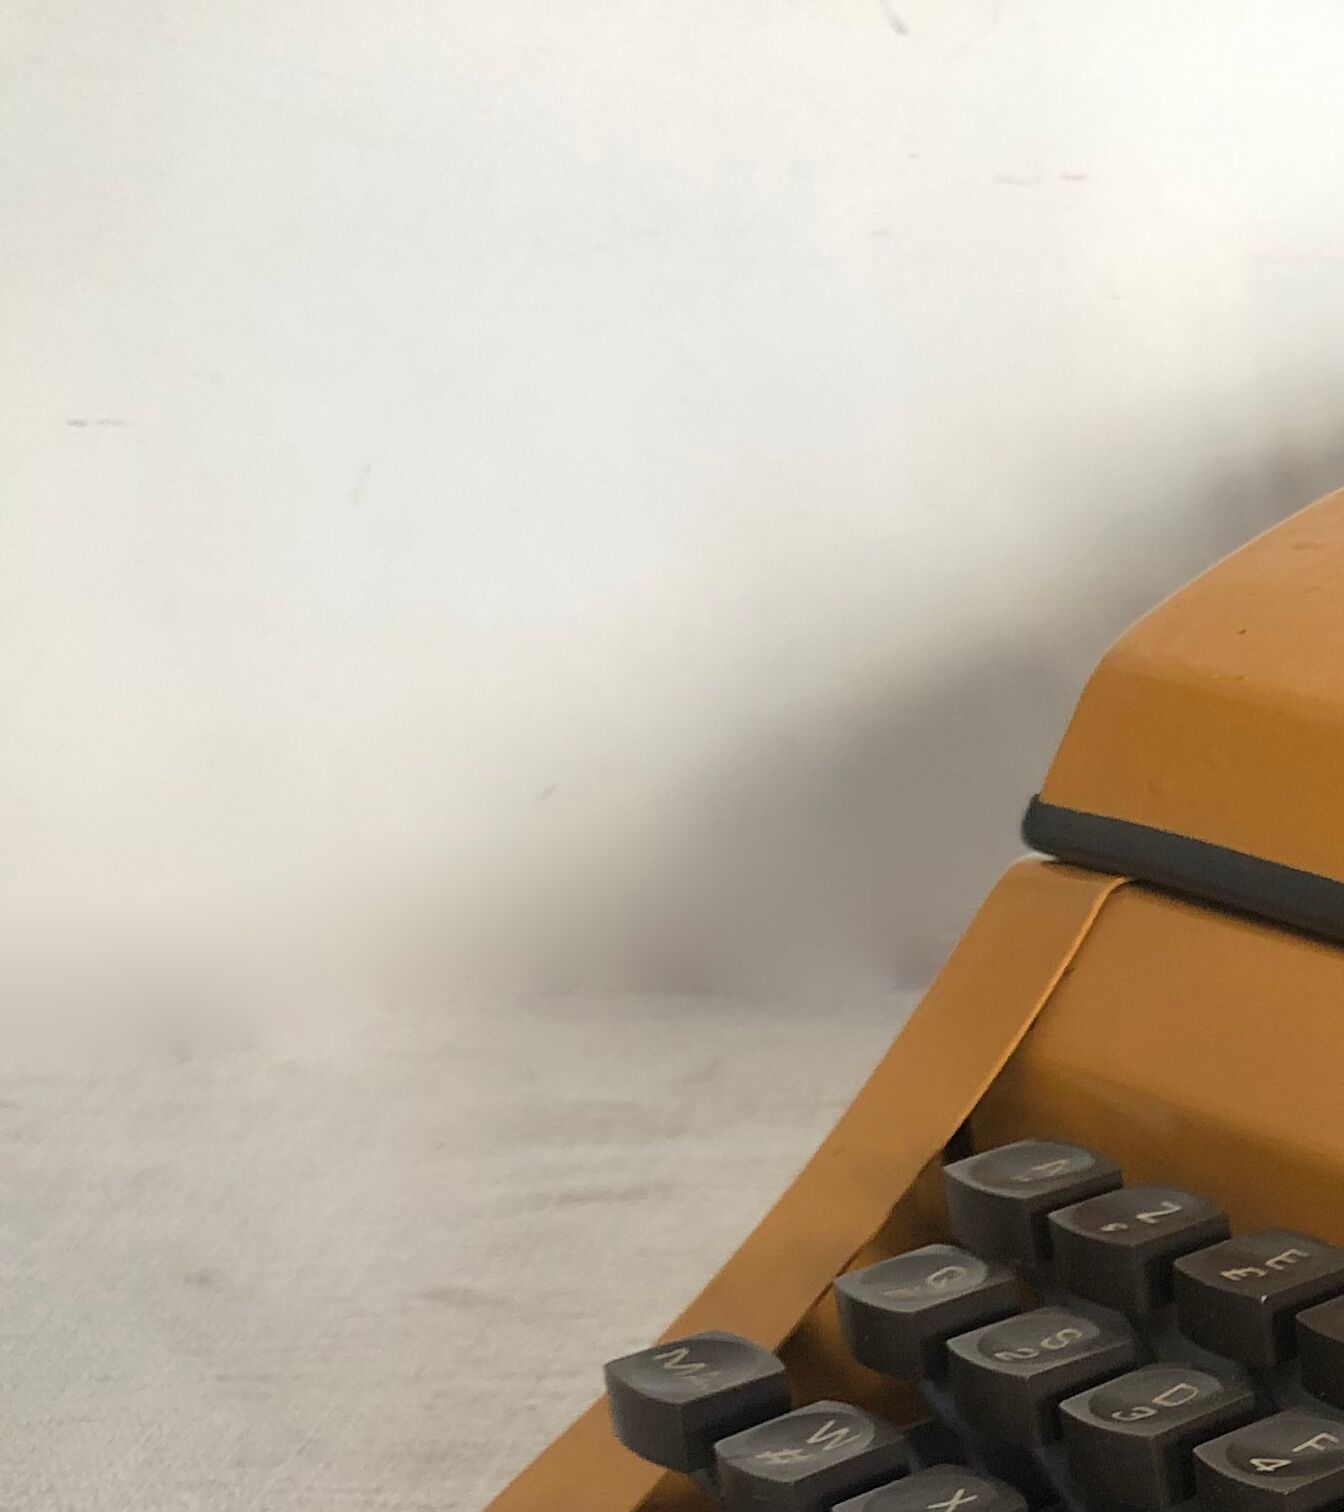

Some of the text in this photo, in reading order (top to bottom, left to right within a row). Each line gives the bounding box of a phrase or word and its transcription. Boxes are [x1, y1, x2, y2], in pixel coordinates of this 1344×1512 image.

[1136, 1201, 1183, 1225] Z
[1265, 1248, 1310, 1270] E
[1040, 1328, 1083, 1350] S
[994, 1348, 1039, 1361] 2
[1152, 1382, 1199, 1407] D
[1112, 1406, 1157, 1422] 3
[806, 1419, 861, 1450] W
[1292, 1432, 1339, 1452] F
[1249, 1456, 1292, 1473] 4
